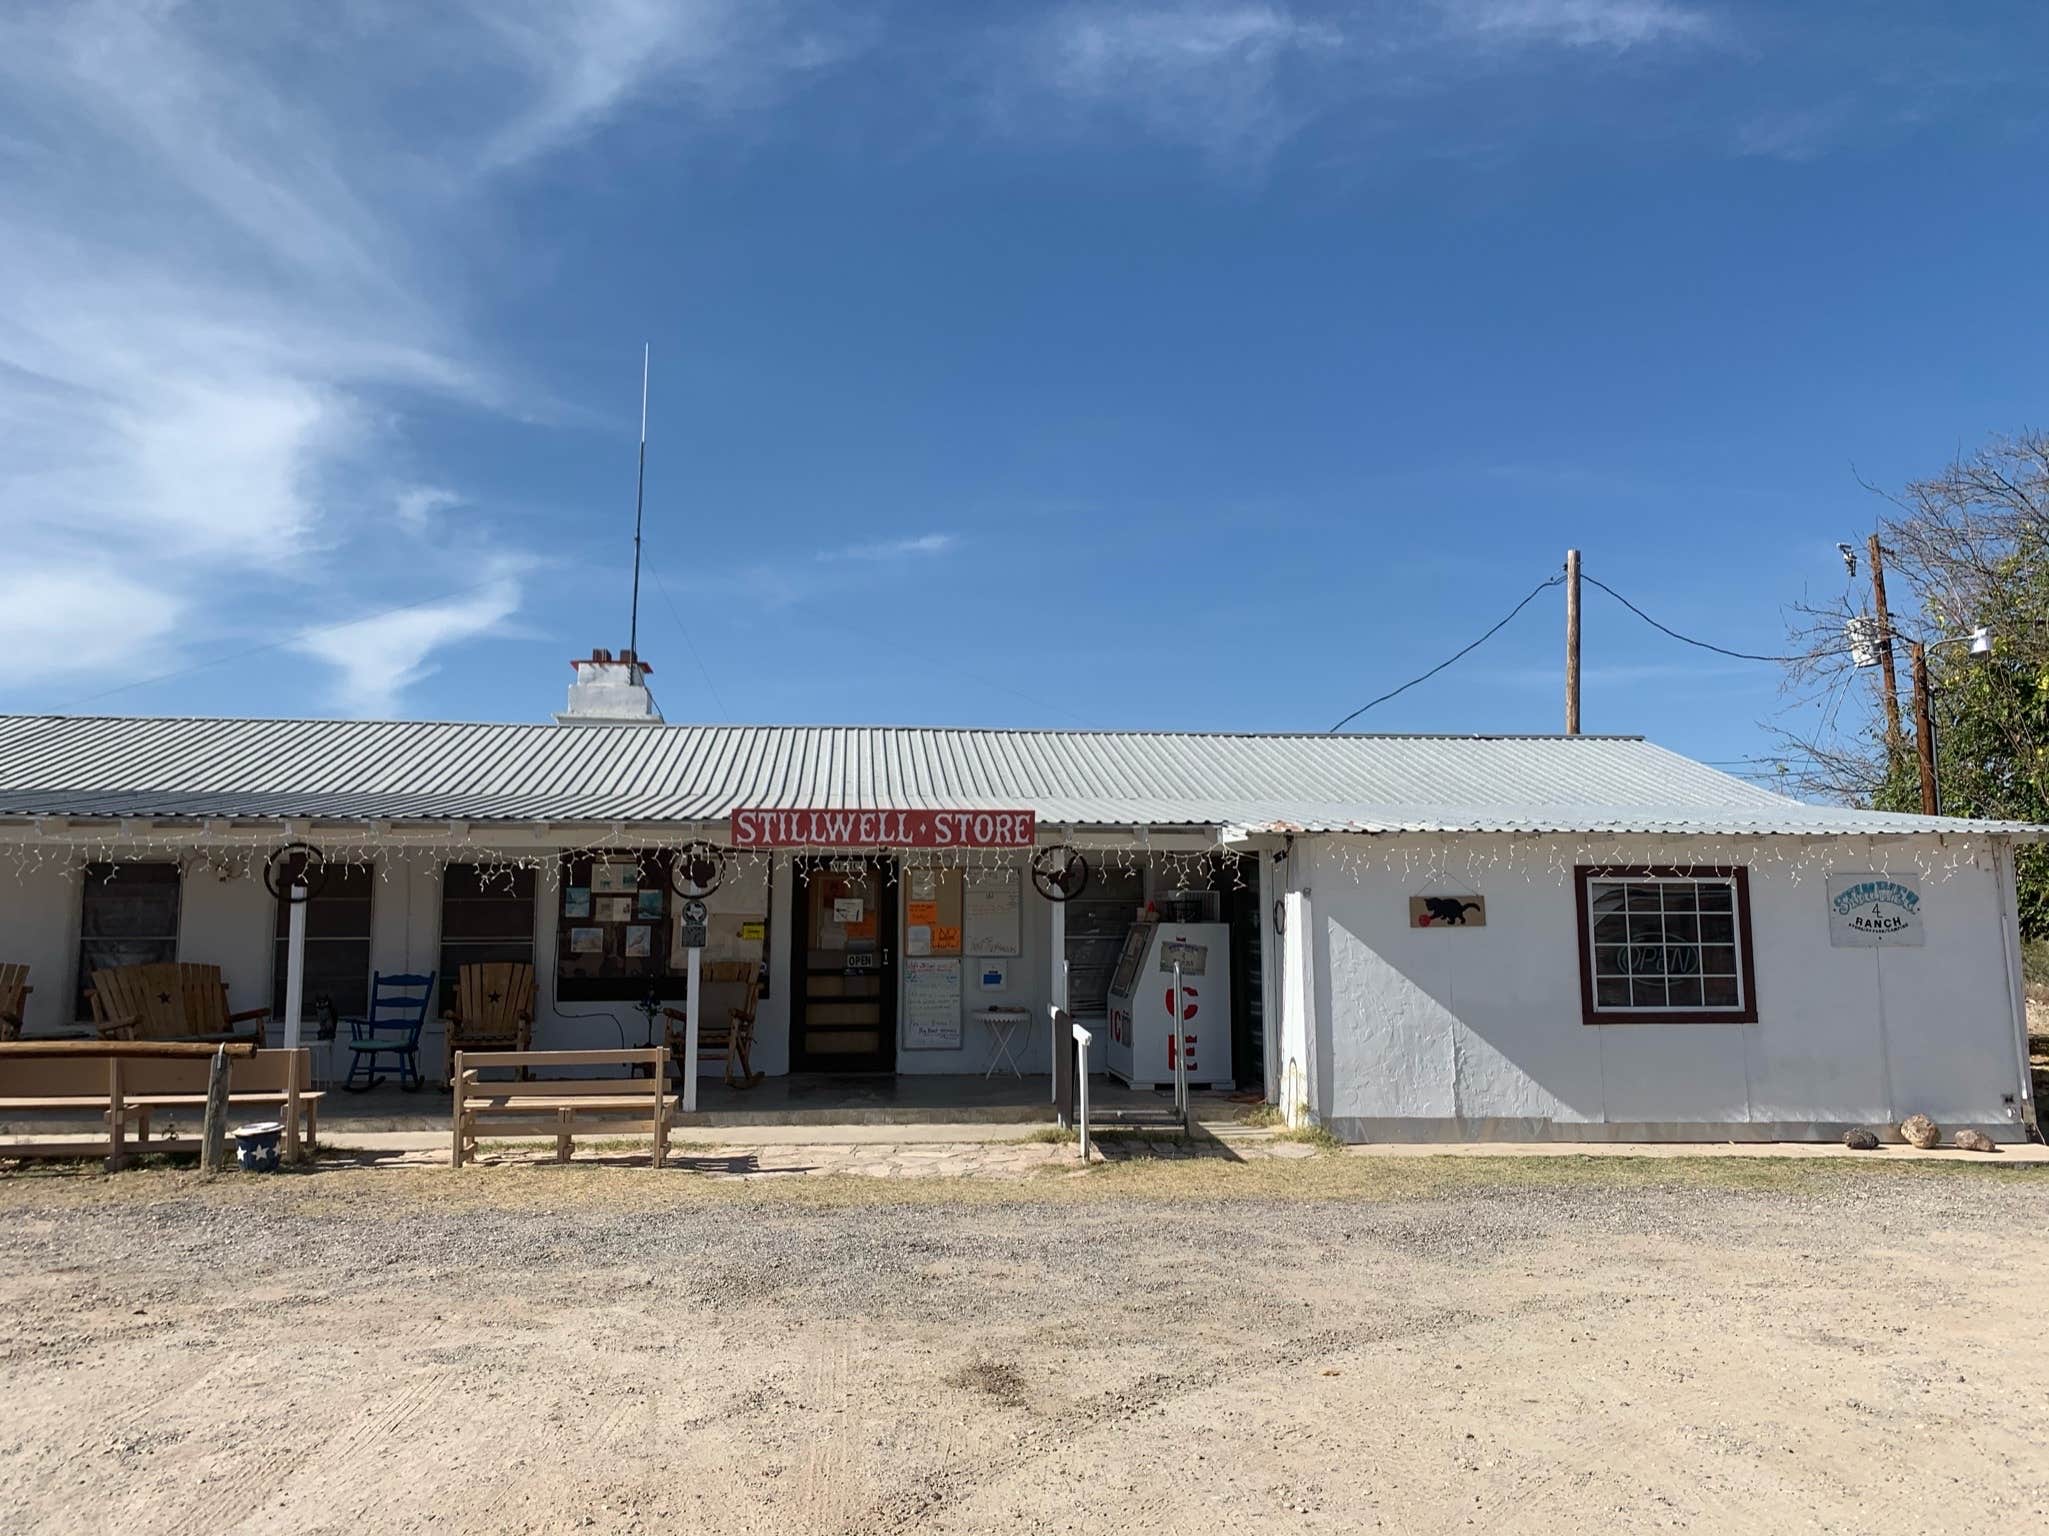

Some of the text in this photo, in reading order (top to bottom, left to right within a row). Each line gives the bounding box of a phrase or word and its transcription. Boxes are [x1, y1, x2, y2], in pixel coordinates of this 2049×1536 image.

[736, 811, 1031, 844] STILLWELL STORE
[1855, 916, 1902, 929] RANCH
[848, 955, 871, 966] OPEN
[1621, 945, 1691, 974] OPEN
